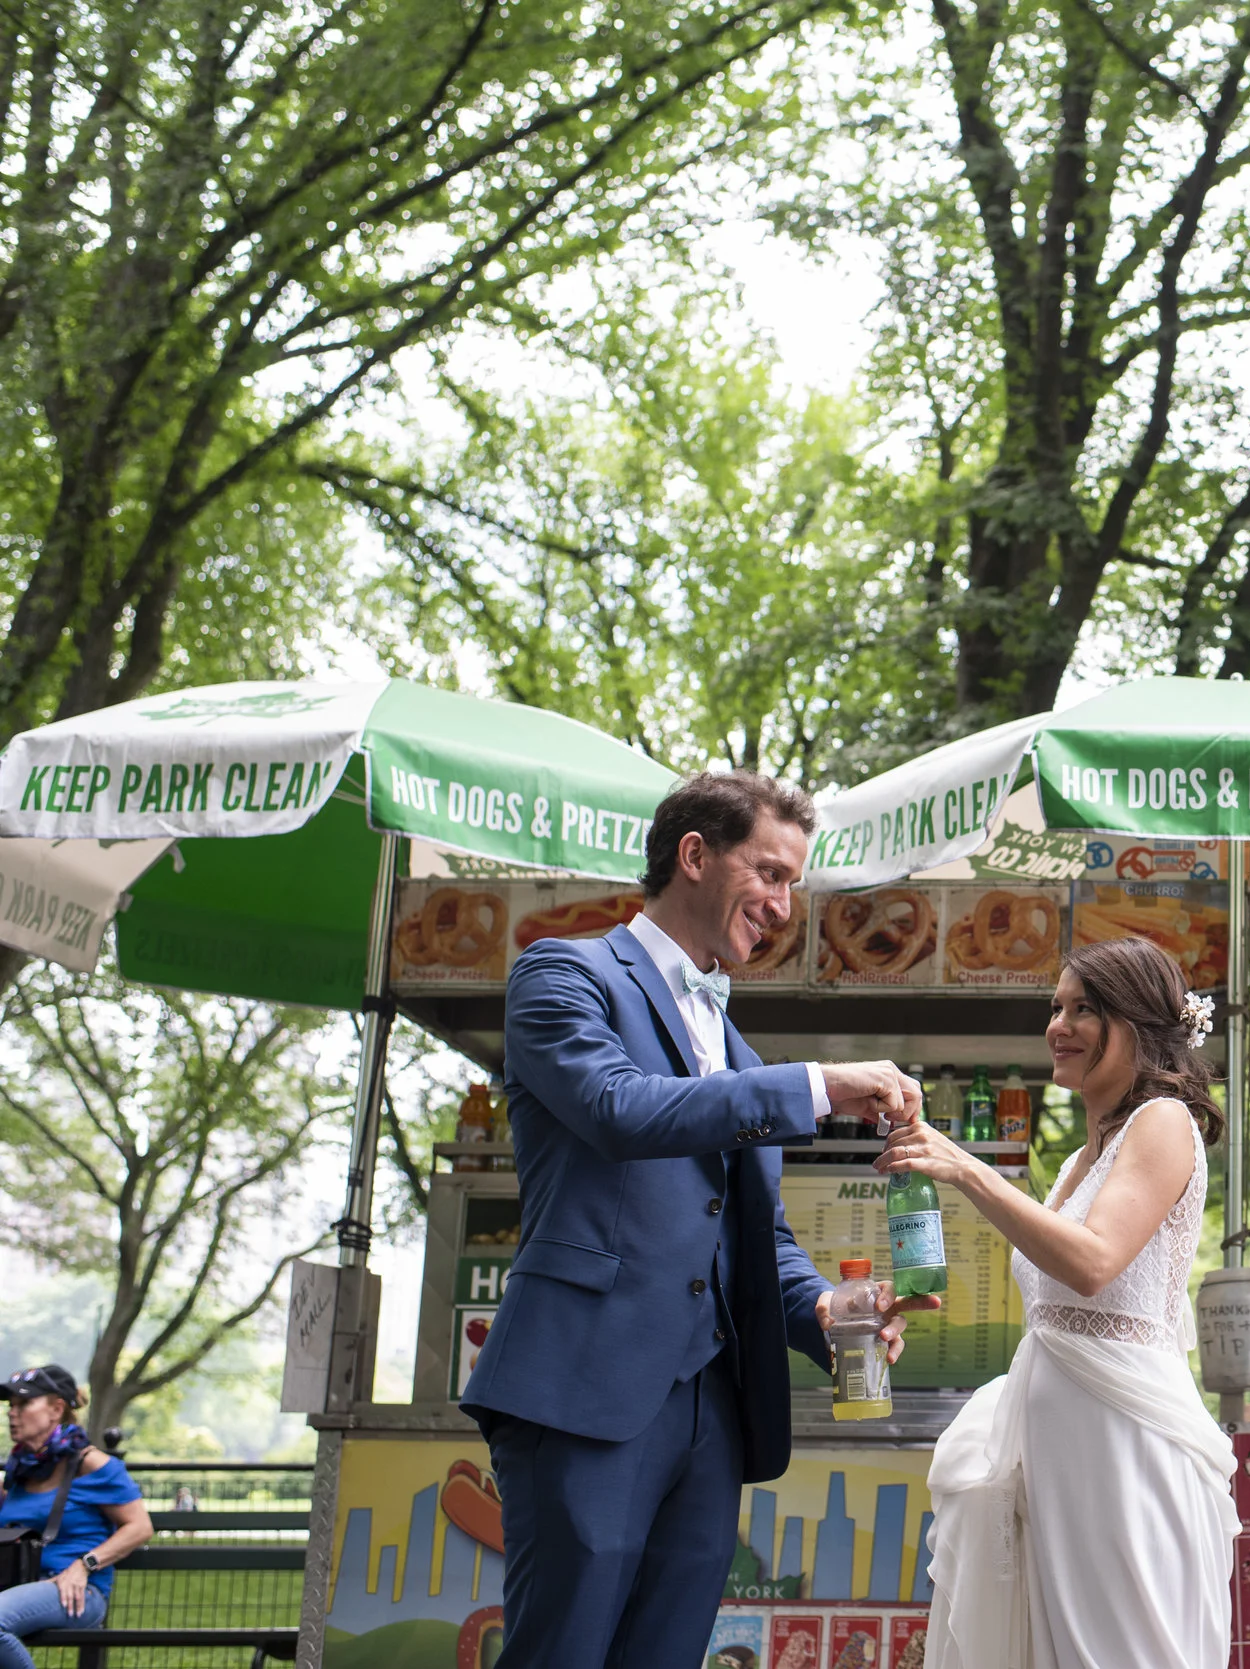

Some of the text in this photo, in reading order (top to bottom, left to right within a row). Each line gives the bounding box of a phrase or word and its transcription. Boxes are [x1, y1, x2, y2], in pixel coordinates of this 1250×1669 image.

[20, 765, 110, 812] KEEP
[118, 763, 214, 813] PARK
[1061, 764, 1118, 806] HOT
[1128, 768, 1207, 810] DOGS
[1217, 768, 1238, 808] &
[390, 766, 653, 857] HOT DOGS & PRETZE
[809, 820, 873, 870] KEEP
[880, 796, 935, 860] PARK
[842, 970, 909, 985] Hot Pretzel
[957, 971, 1049, 984] Cheese Pretzel
[837, 1182, 888, 1199] MEN
[1200, 1304, 1250, 1319] THANKS
[1213, 1321, 1235, 1332] FOR
[1202, 1334, 1245, 1356] TIP
[733, 1585, 785, 1599] YORK
